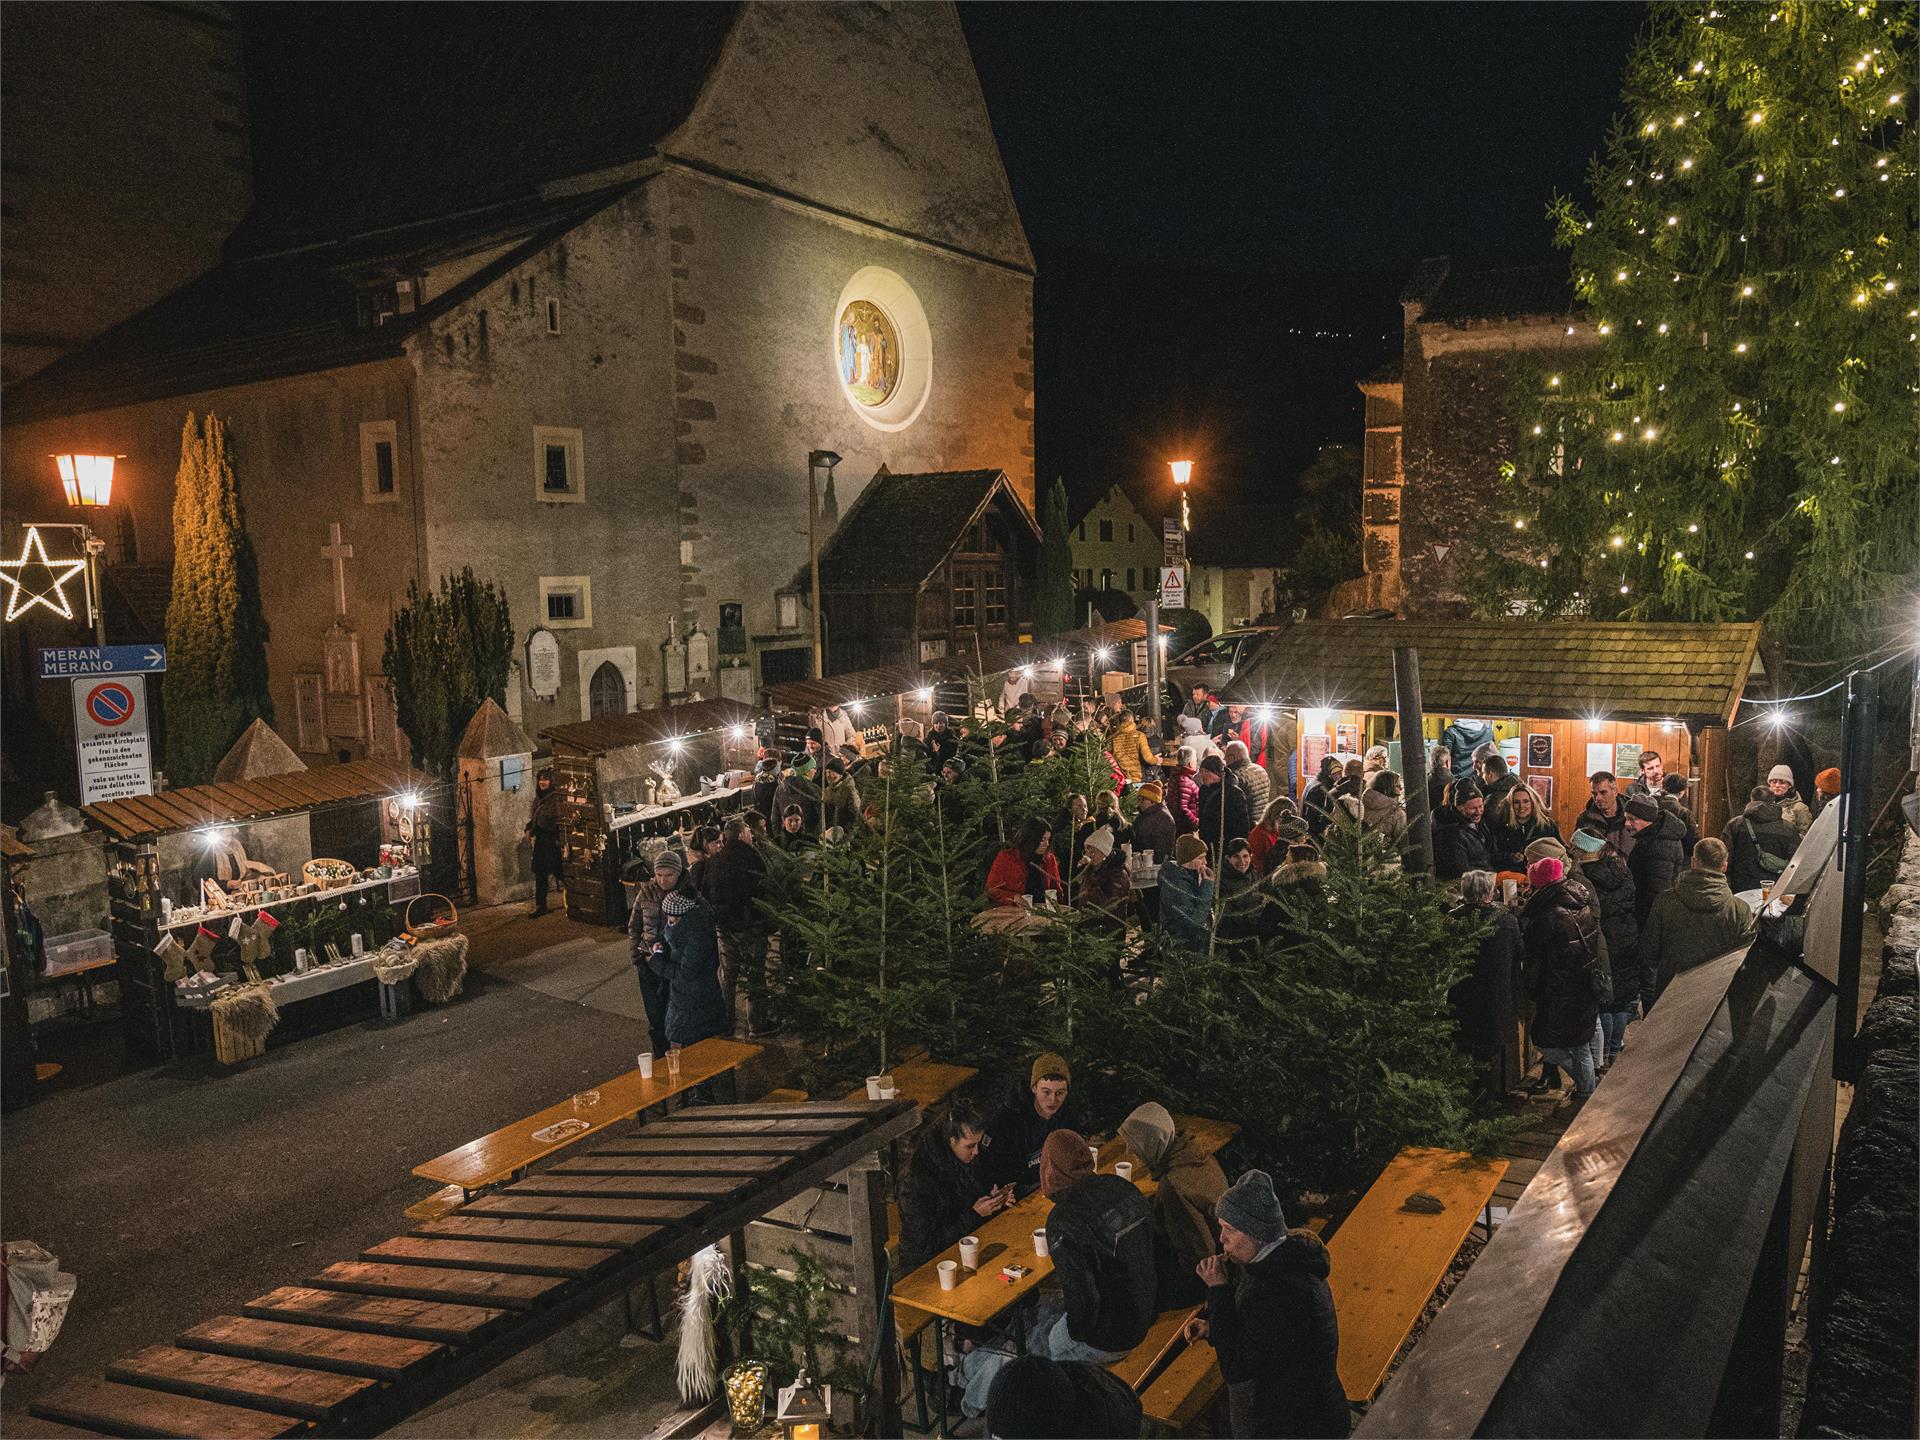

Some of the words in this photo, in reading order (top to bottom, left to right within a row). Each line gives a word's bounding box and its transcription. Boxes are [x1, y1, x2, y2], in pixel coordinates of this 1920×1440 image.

[43, 648, 101, 662] MERAN
[44, 660, 114, 674] MERANO
[94, 733, 106, 741] gilt
[81, 739, 112, 749] gesamten
[114, 736, 146, 745] Kirchplatz
[88, 752, 143, 764] gekennzeichneten
[104, 761, 128, 769] Flächen
[88, 784, 108, 792] piazza
[102, 790, 124, 798] eccetto
